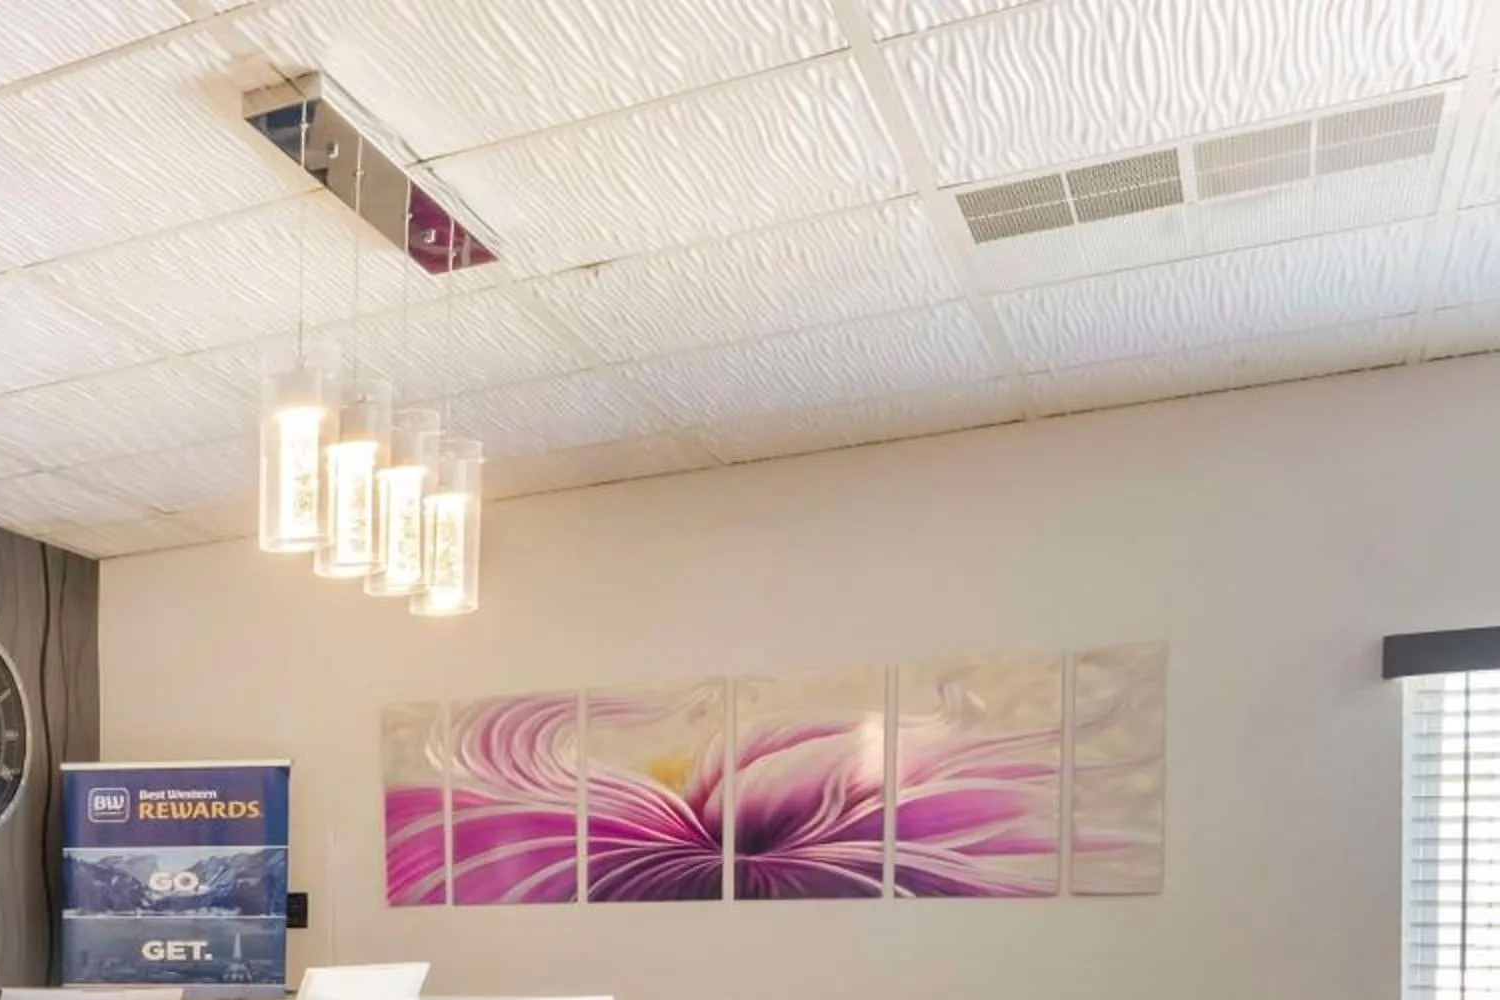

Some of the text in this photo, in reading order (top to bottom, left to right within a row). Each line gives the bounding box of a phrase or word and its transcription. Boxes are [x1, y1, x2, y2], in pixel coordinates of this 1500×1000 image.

[93, 795, 125, 811] BW
[139, 789, 217, 800] Best Western
[139, 800, 261, 820] REWARDS
[141, 940, 213, 961] GET.
